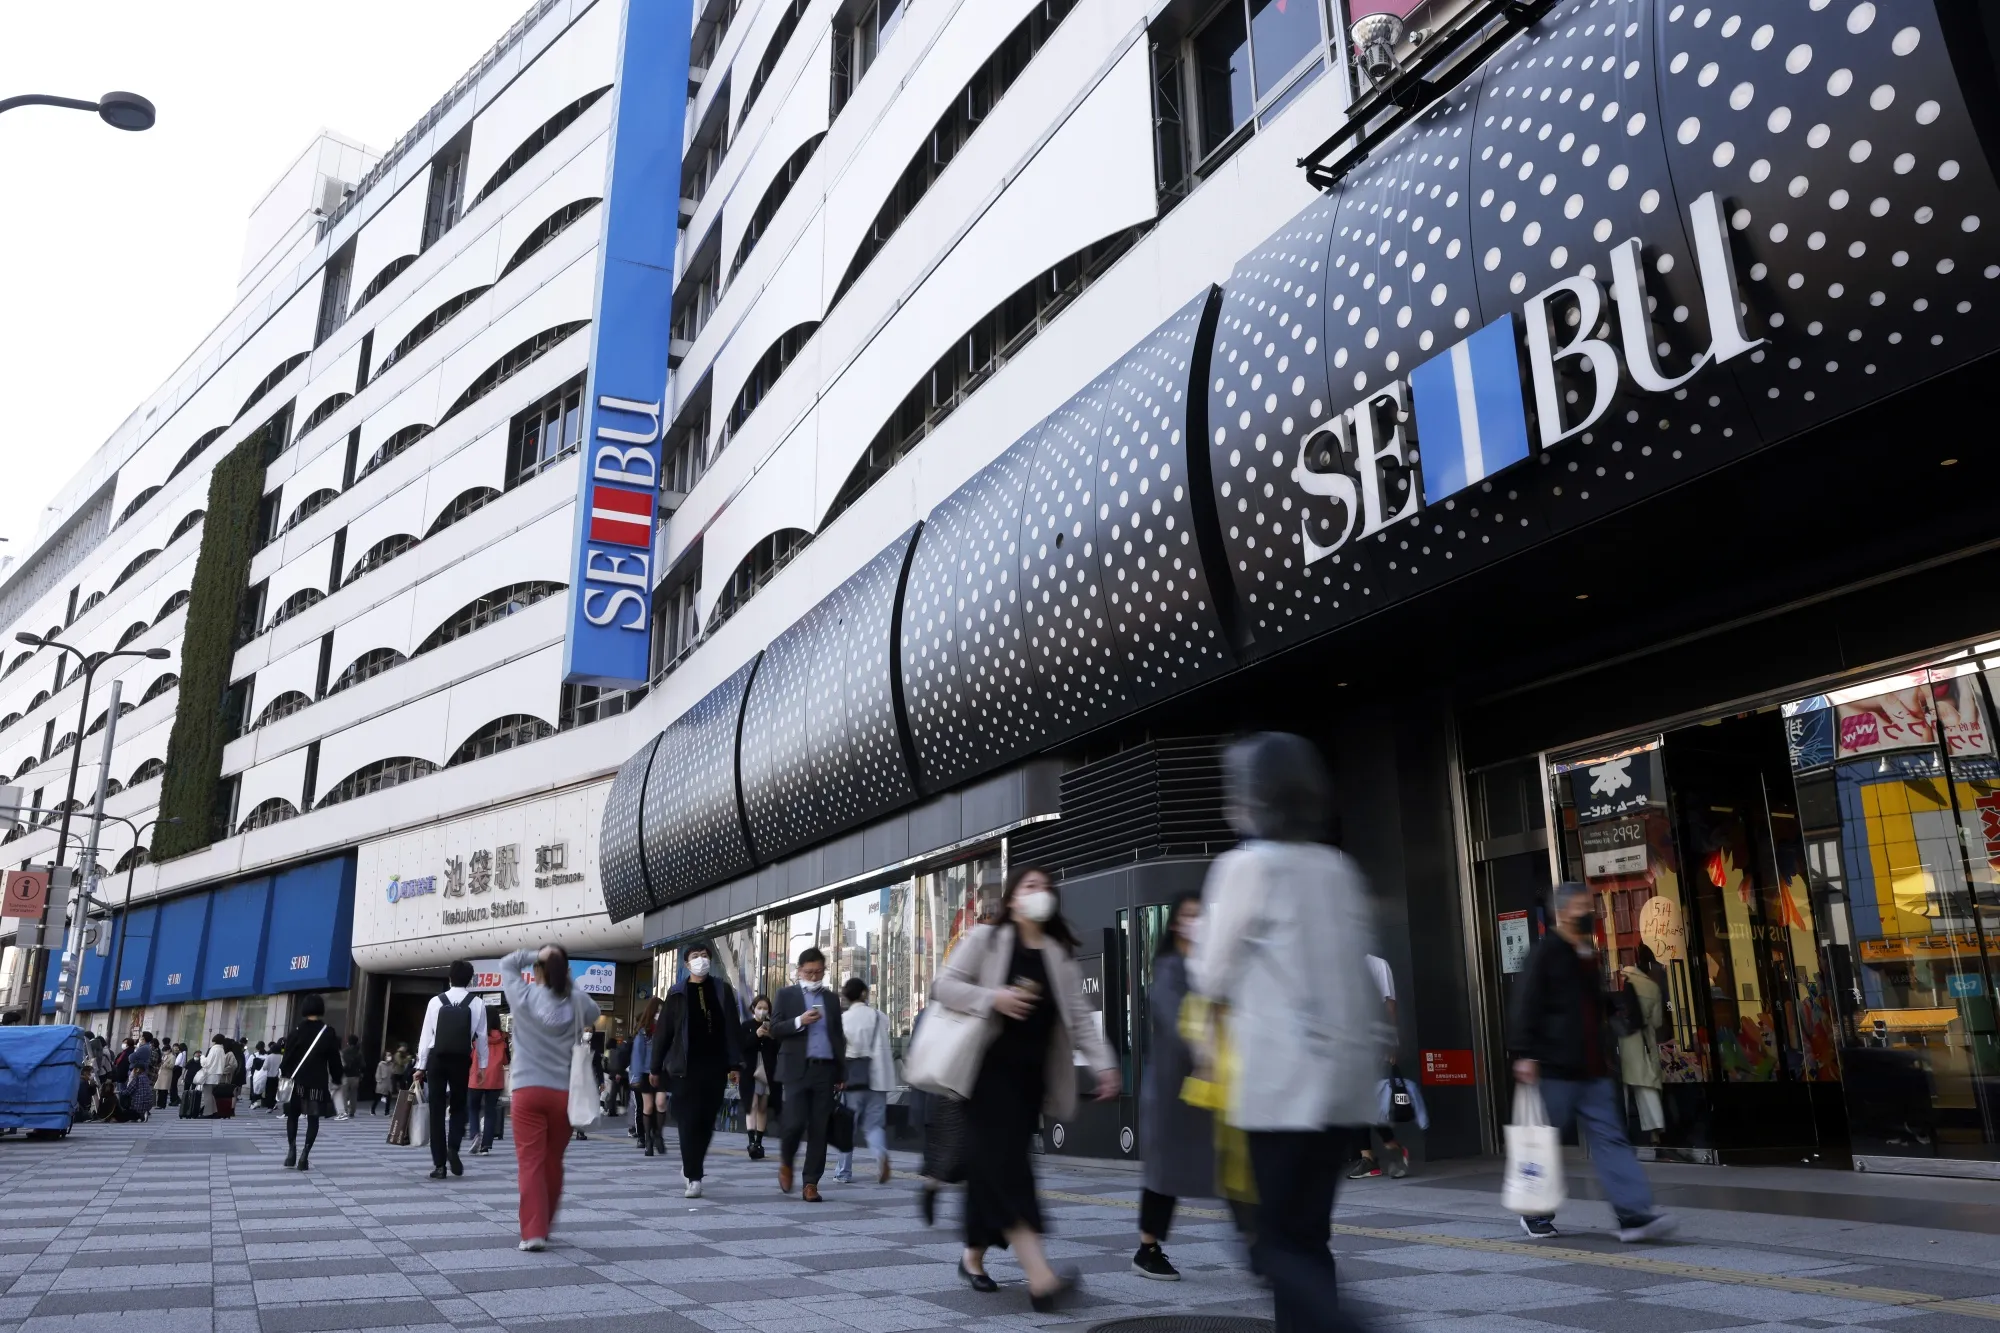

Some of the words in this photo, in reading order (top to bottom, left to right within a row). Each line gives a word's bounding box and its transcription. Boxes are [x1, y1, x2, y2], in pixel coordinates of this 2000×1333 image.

[1296, 190, 1772, 566] SEIBU
[584, 394, 661, 631] SEIBU
[443, 843, 520, 898] 池袋駅
[535, 841, 568, 873] 東口
[443, 906, 488, 925] Ikebukuro
[490, 900, 528, 919] Station
[1654, 903, 1672, 917] 5.14
[1644, 918, 1684, 938] Mother's
[1653, 939, 1677, 958] Day
[222, 965, 239, 979] SEIBU
[290, 955, 310, 970] SEIBU
[167, 973, 182, 986] SEIBU
[1081, 977, 1099, 994] ATM
